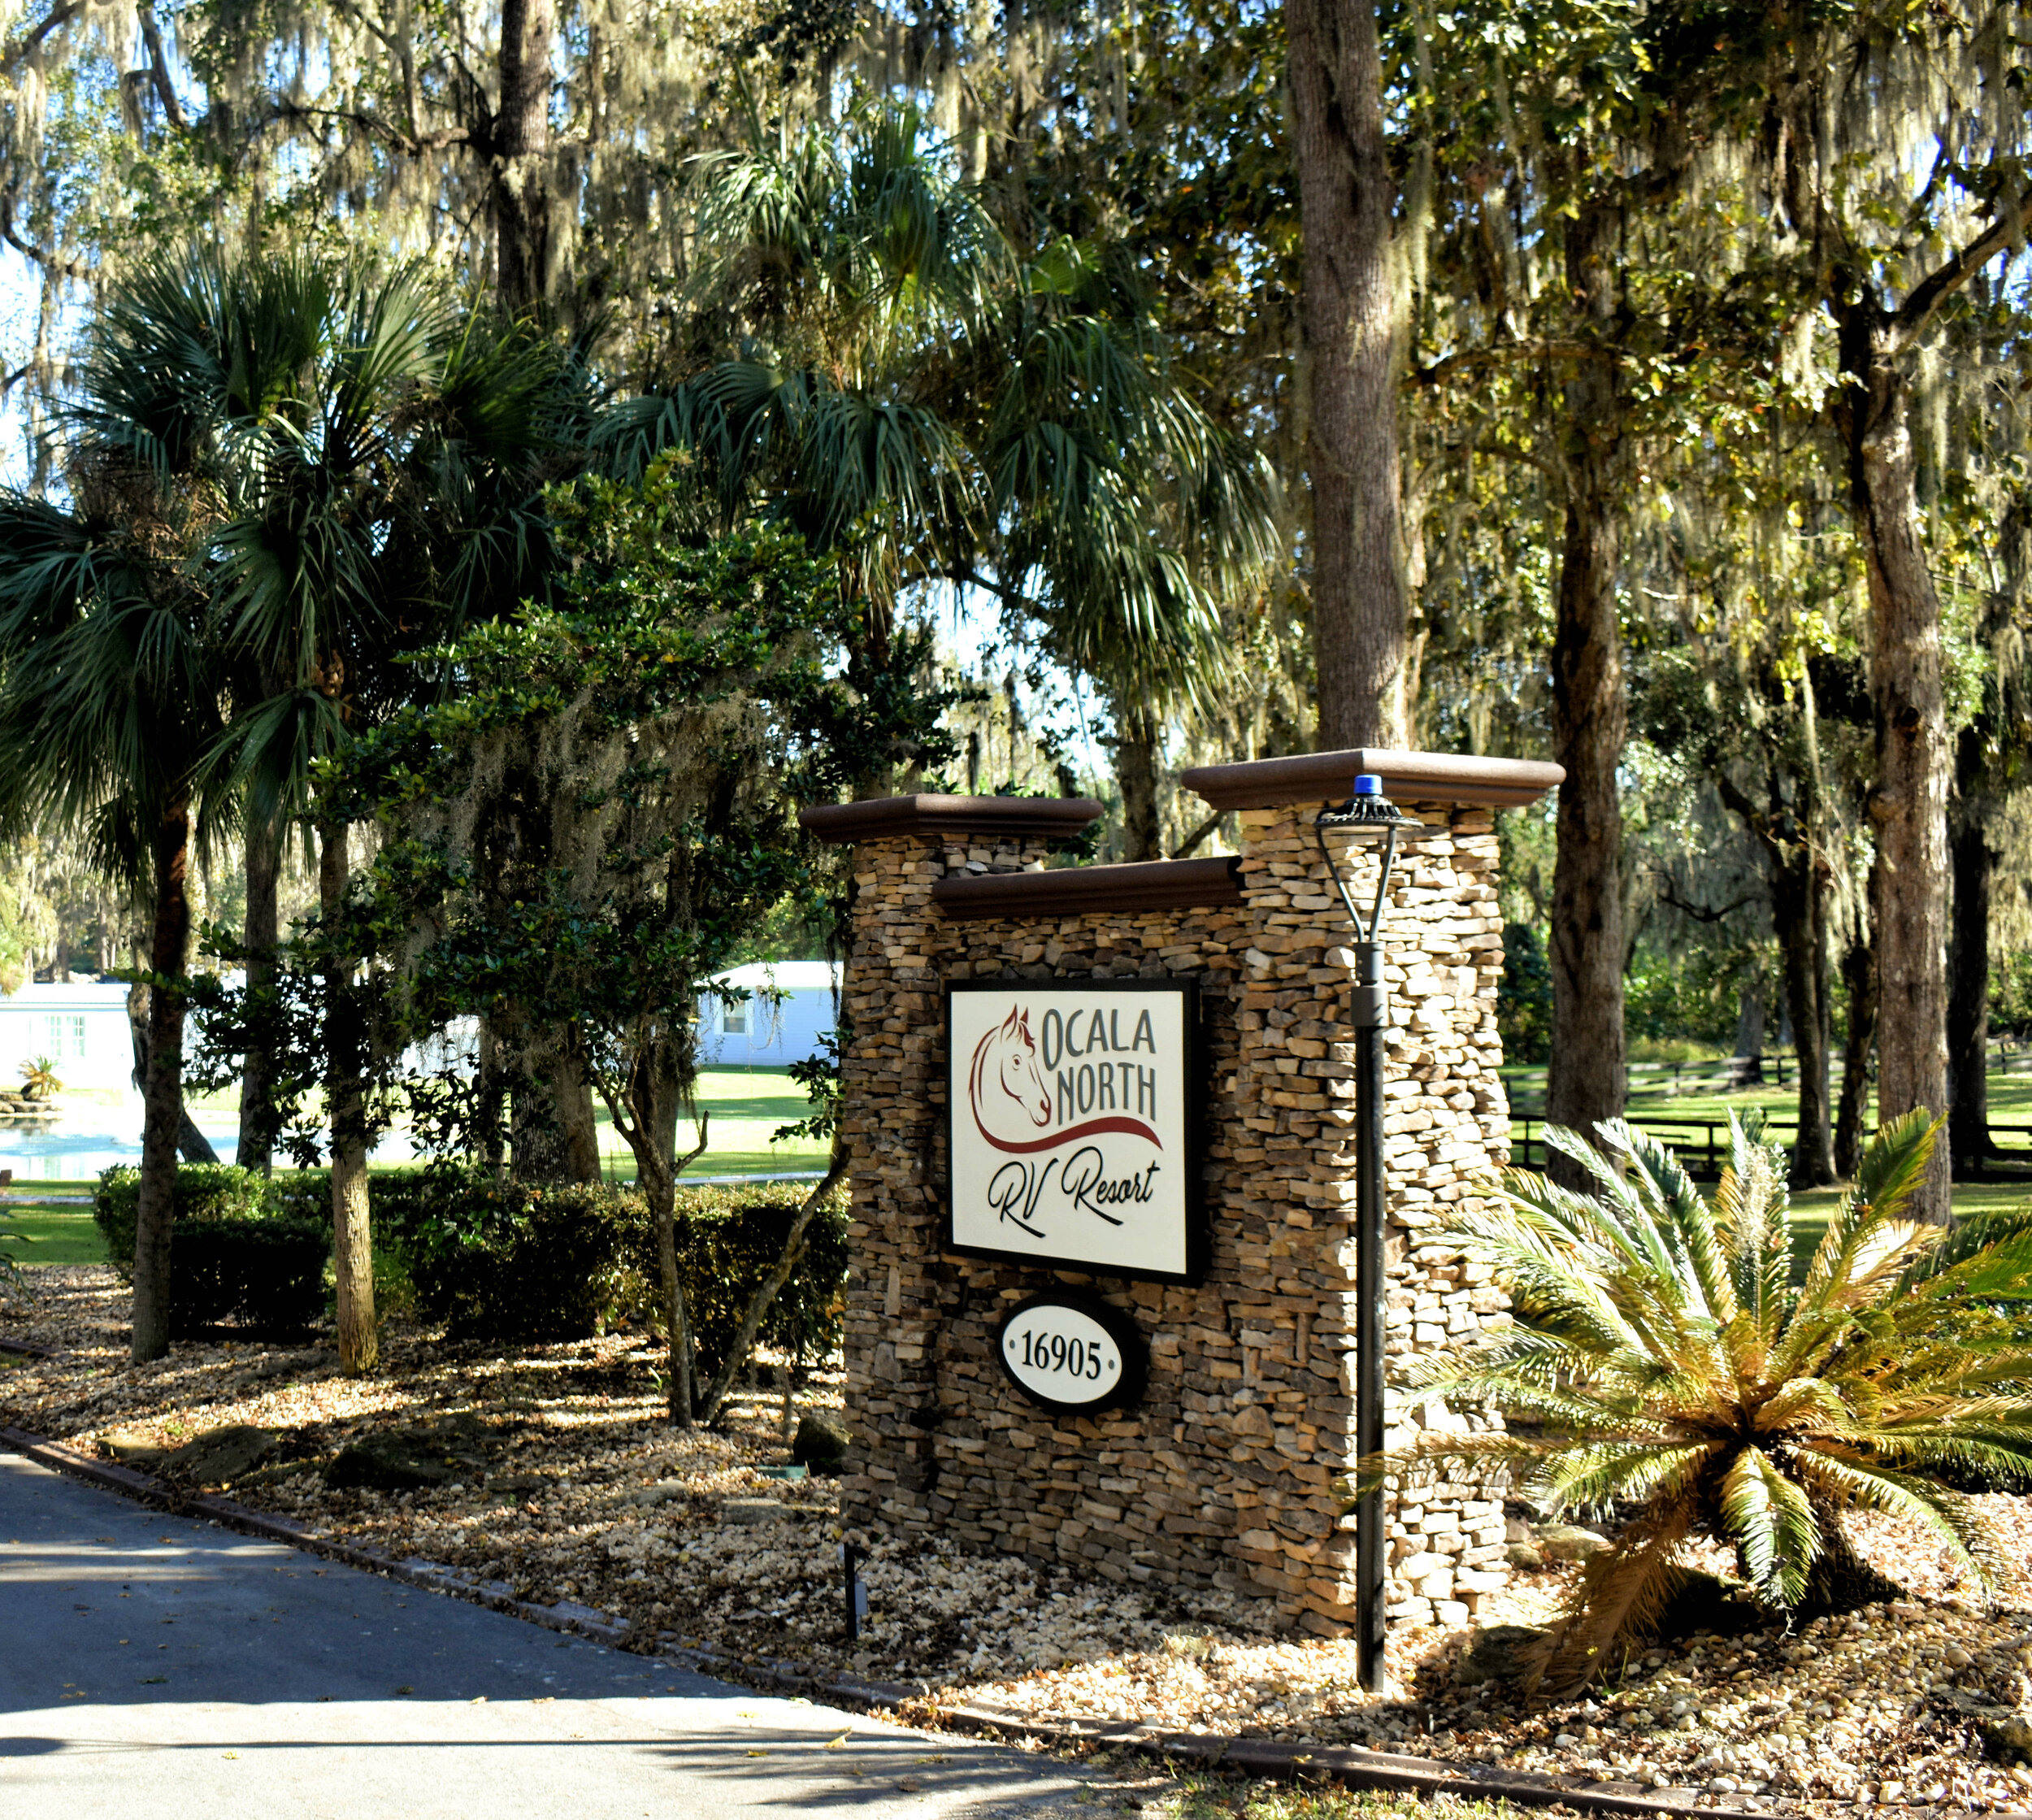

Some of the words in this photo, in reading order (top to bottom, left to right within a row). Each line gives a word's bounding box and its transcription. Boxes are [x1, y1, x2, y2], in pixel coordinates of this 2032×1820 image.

[1042, 1008, 1157, 1071] OCALA
[1057, 1062, 1157, 1126] NORTH
[988, 1158, 1059, 1238] RV
[1061, 1145, 1161, 1226] Resort
[1021, 1329, 1101, 1379] 16905
